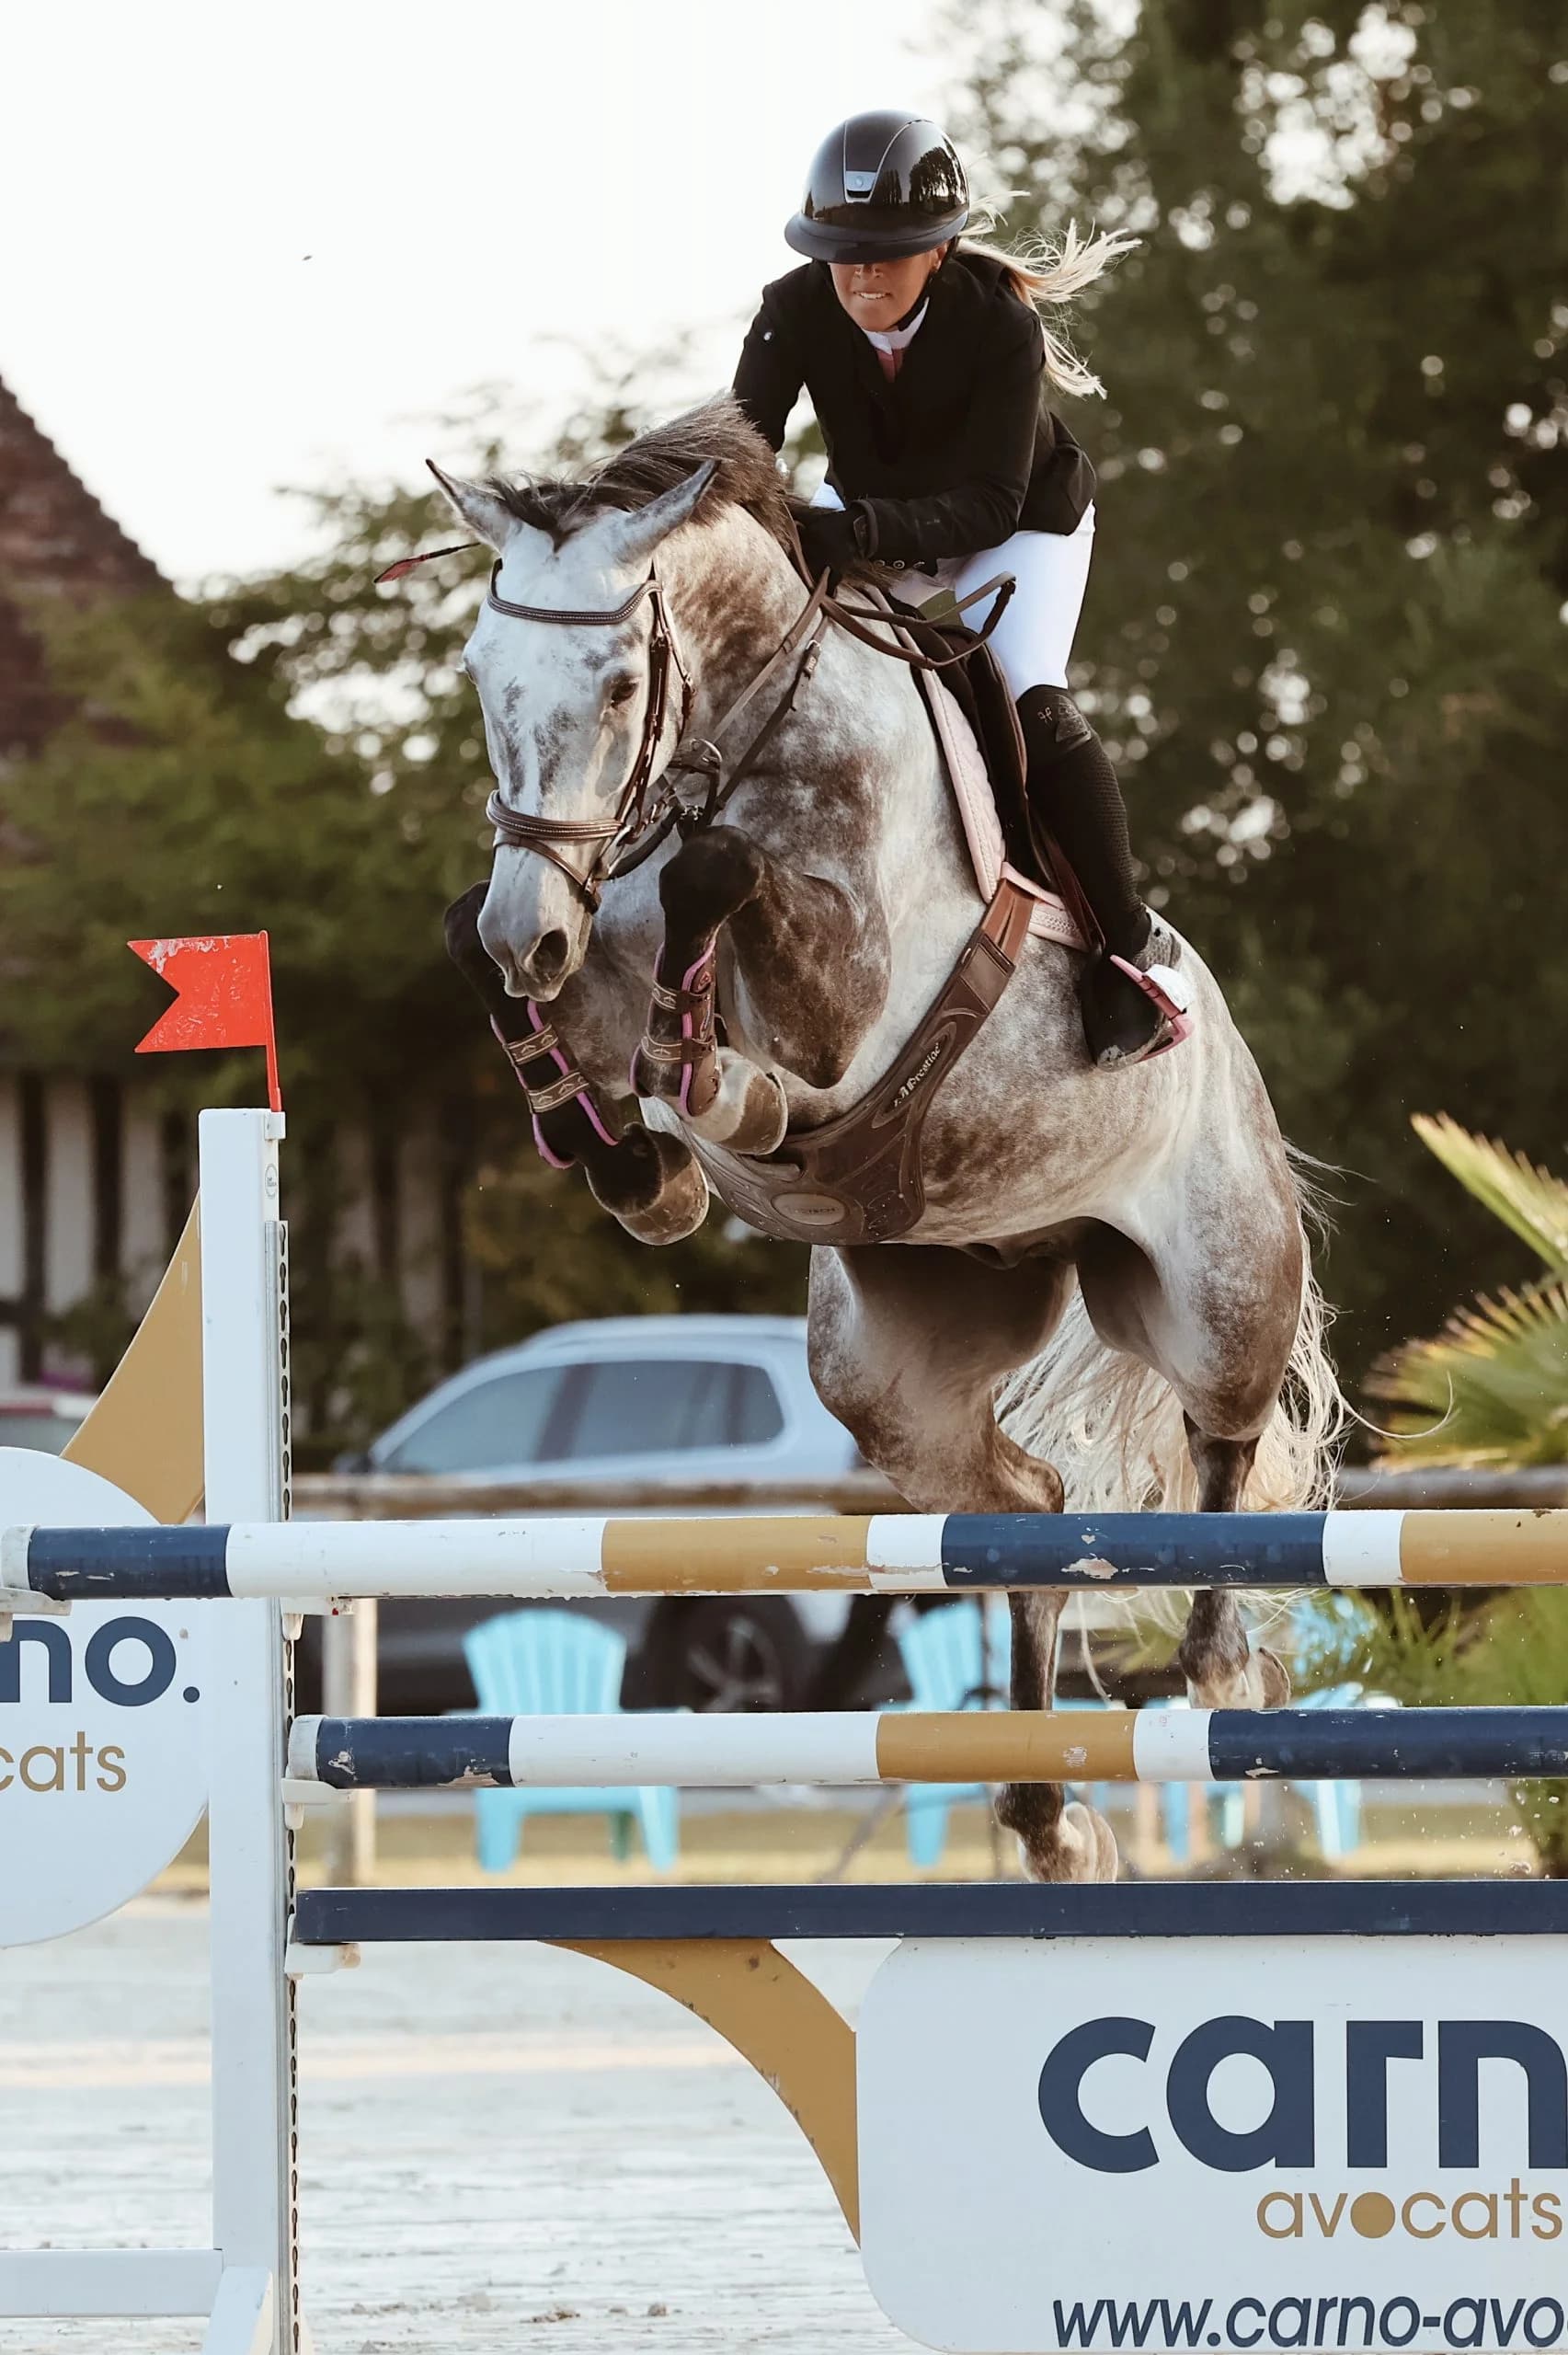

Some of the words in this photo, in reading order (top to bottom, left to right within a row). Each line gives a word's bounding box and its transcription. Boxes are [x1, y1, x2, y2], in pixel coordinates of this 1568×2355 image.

[1037, 2015, 1568, 2174] carn
[1256, 2177, 1563, 2240] avocats
[1052, 2295, 1568, 2349] www.carno-avo
